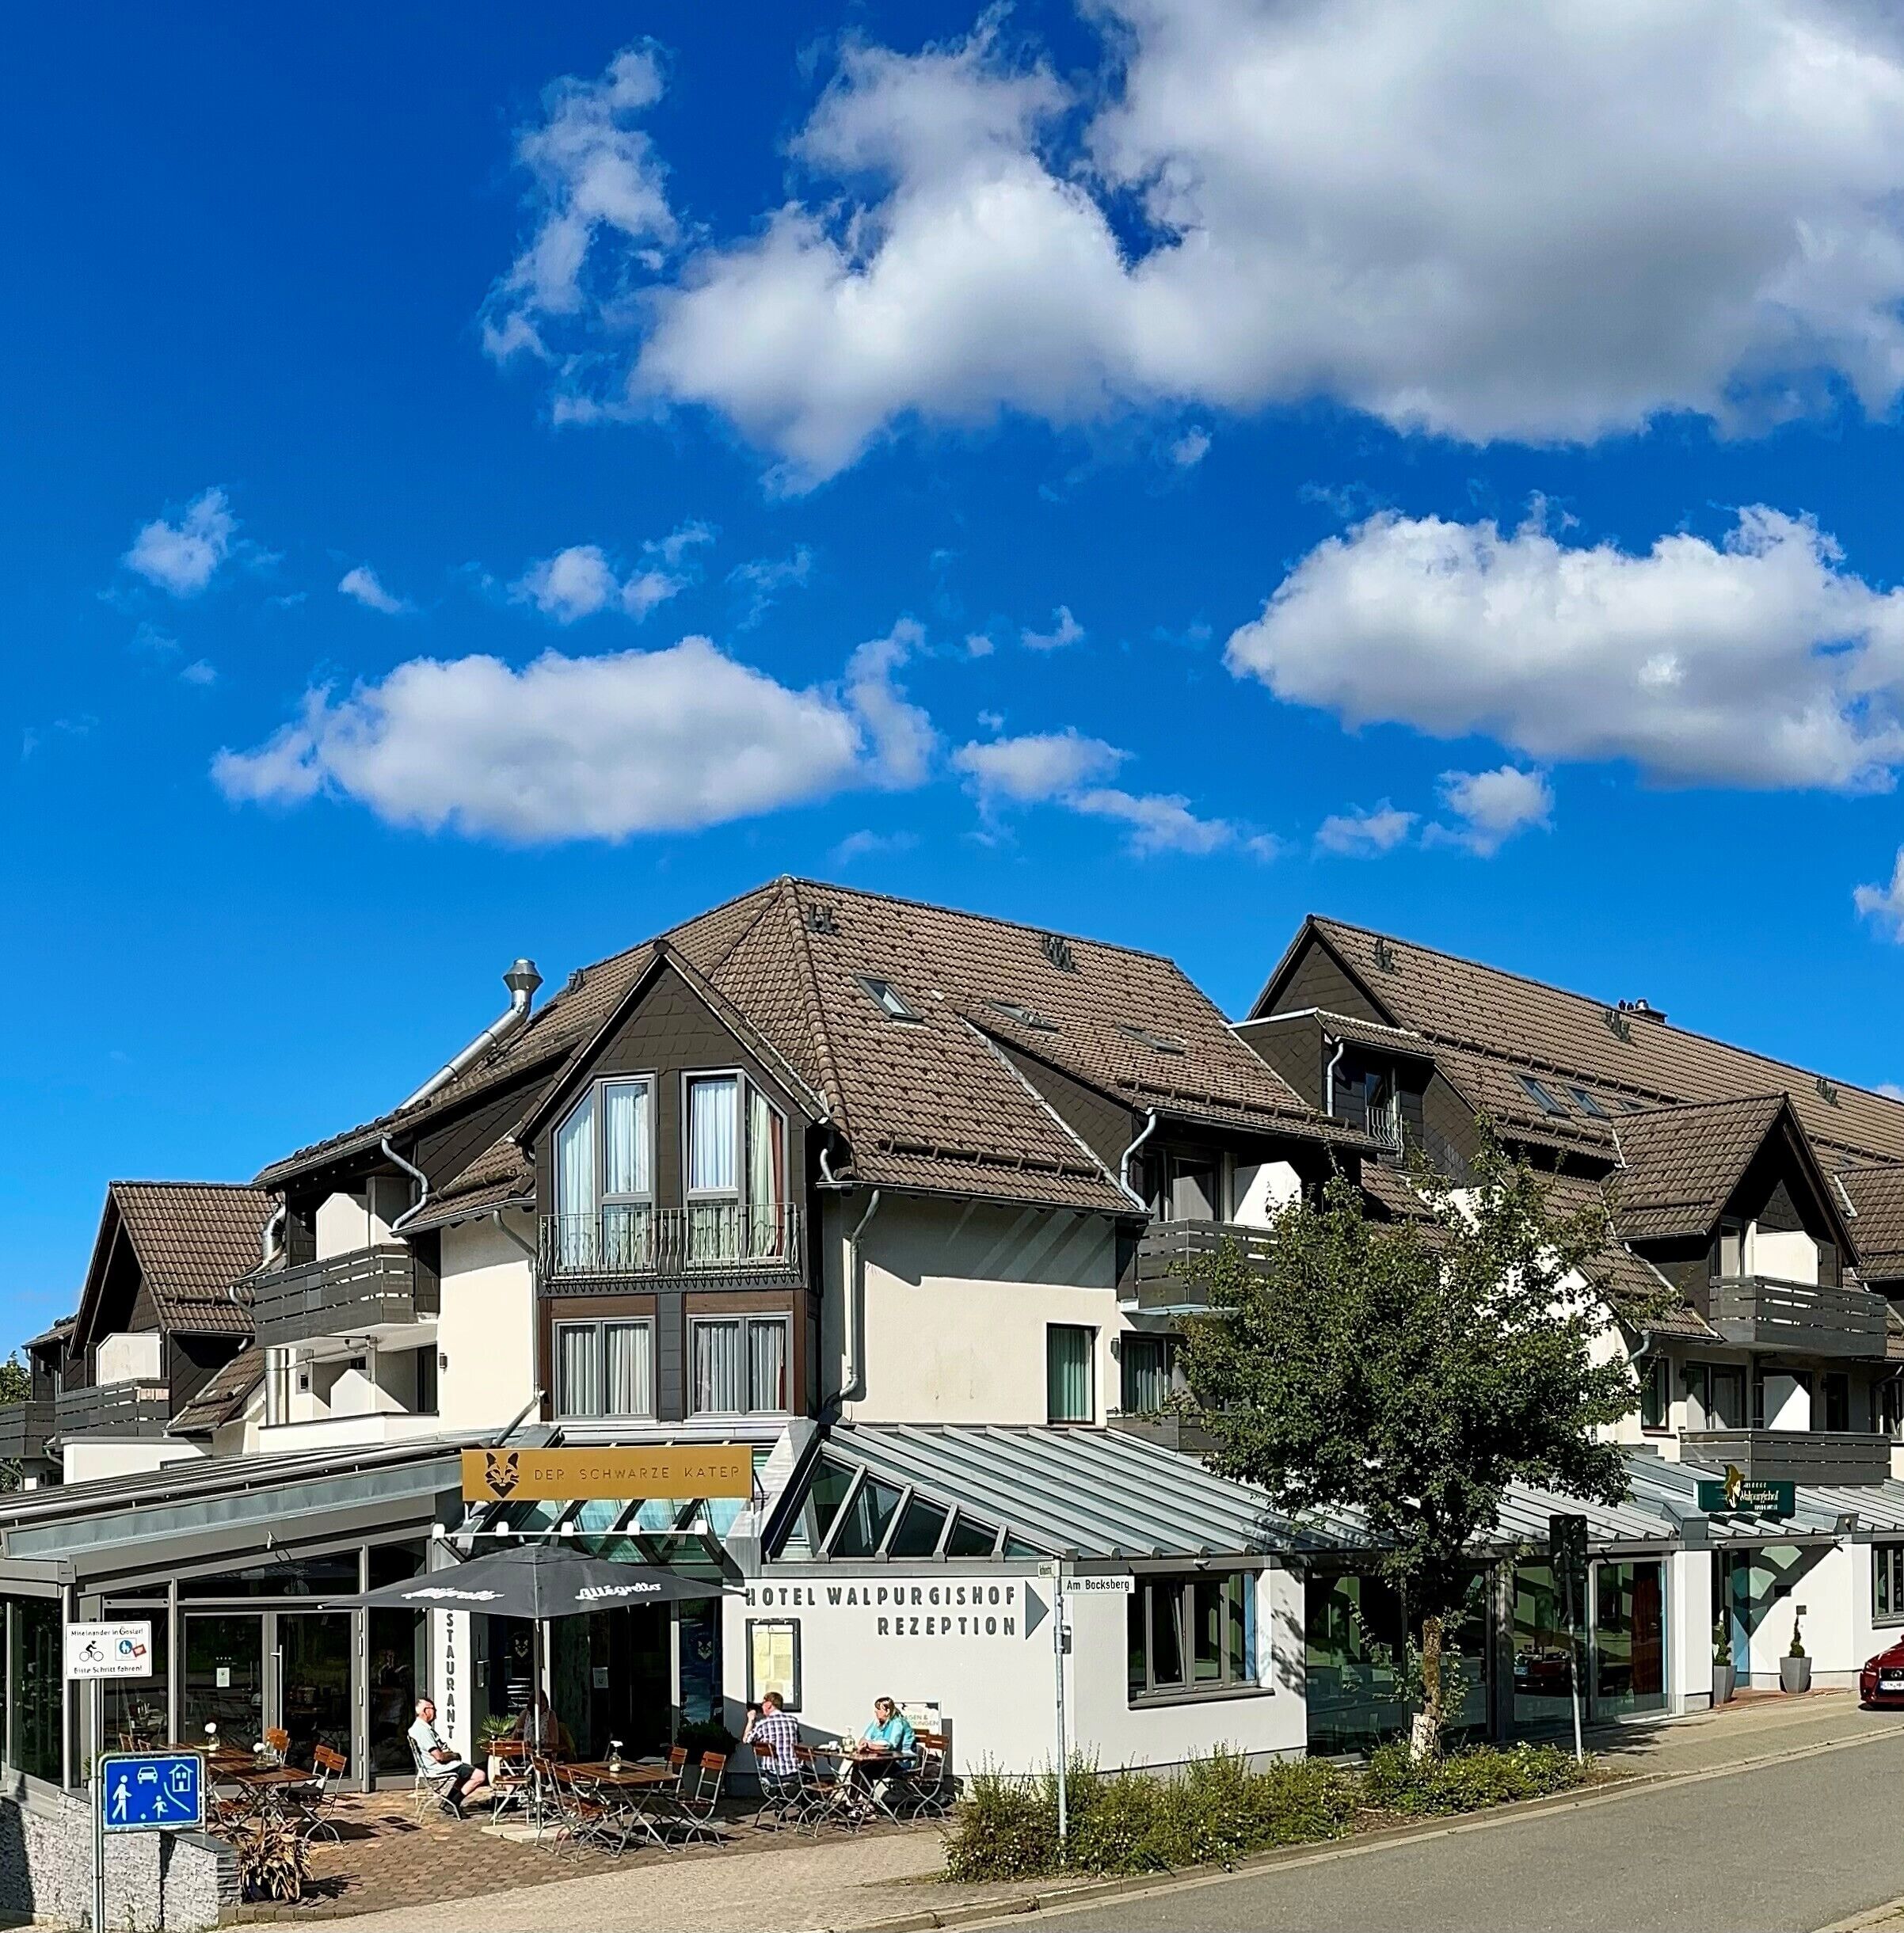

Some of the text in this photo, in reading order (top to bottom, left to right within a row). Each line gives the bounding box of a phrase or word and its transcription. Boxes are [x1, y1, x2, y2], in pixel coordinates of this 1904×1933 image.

[535, 1469, 565, 1480] DER
[579, 1467, 670, 1480] SCHWARZE
[1067, 1579, 1129, 1592] Am Bocksberg
[745, 1586, 1015, 1606] HOTEL WALPURGISHOF
[878, 1617, 1015, 1635] REZEPTION
[446, 1608, 455, 1740] STAURANT
